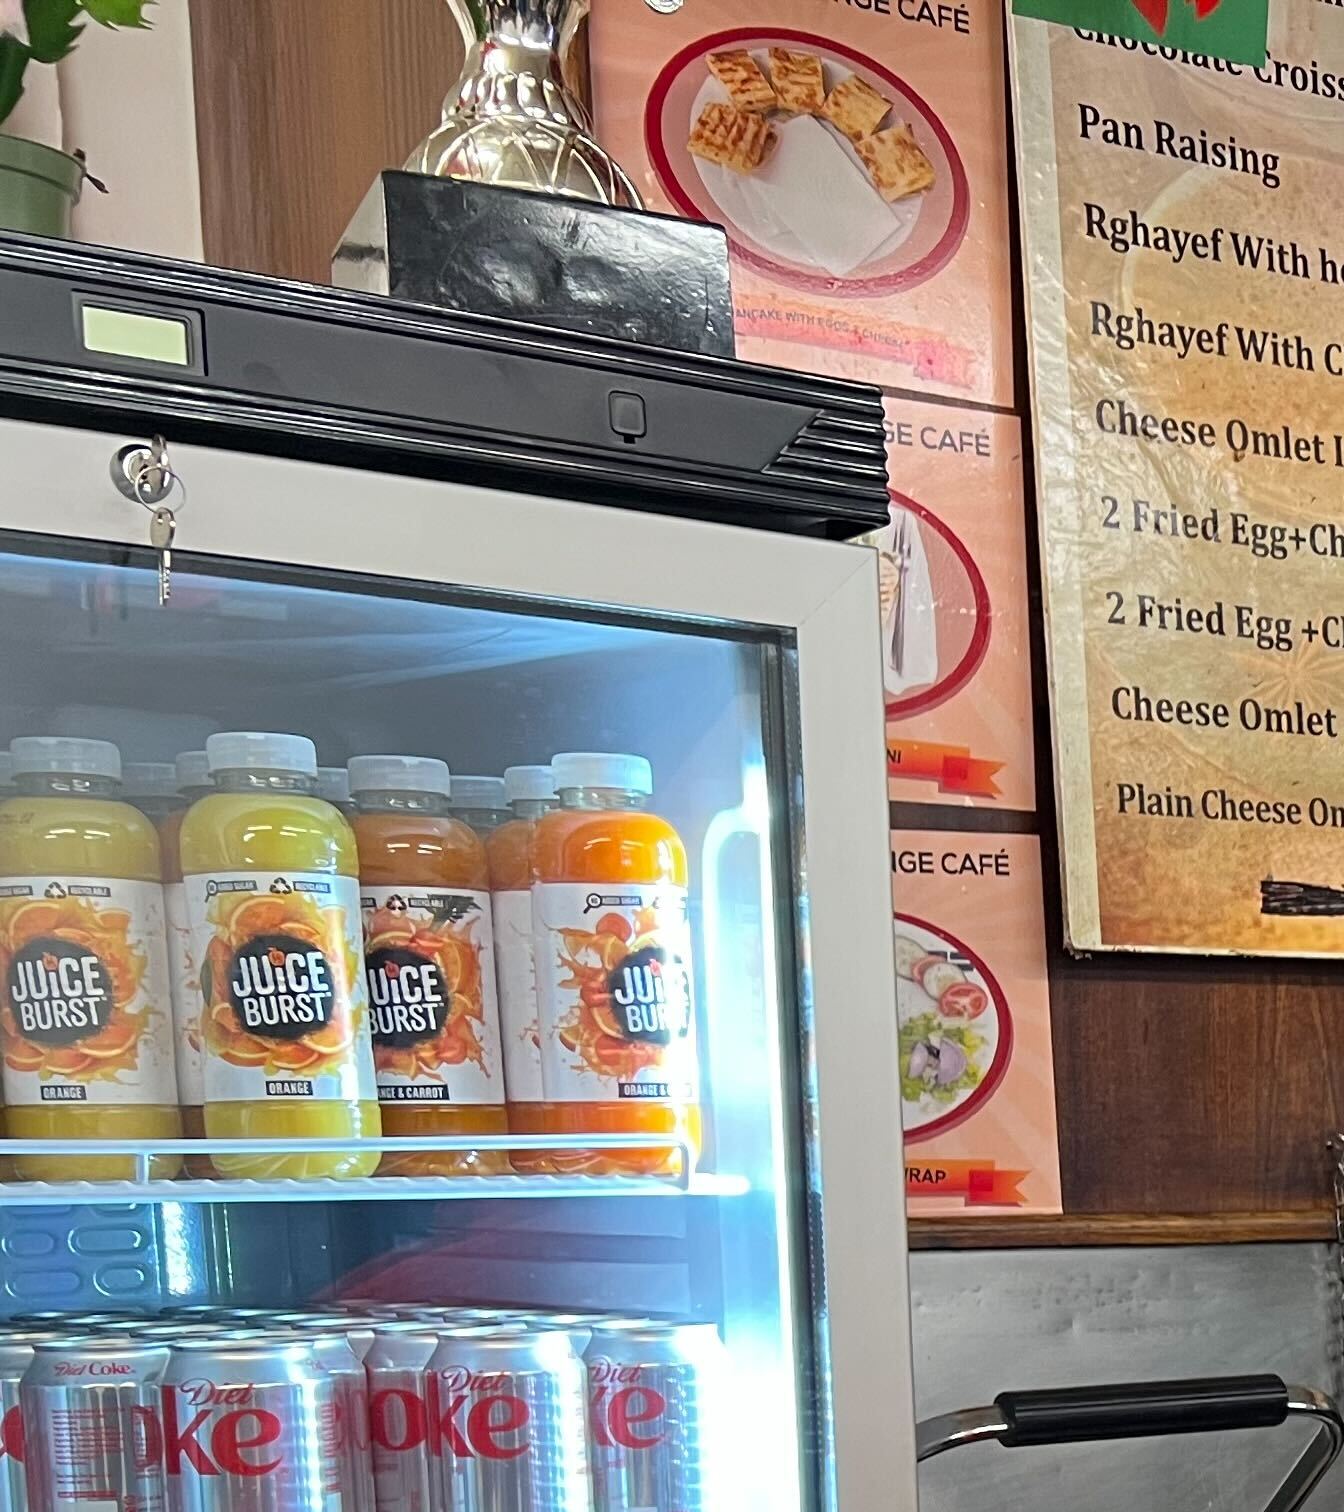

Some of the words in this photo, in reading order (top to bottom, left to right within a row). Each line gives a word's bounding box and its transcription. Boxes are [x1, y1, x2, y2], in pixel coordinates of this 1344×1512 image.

[898, 0, 969, 34] CAFÉ
[1078, 103, 1144, 150] Pan
[1154, 120, 1281, 189] Raising
[1083, 202, 1224, 264] Rghayef
[1231, 231, 1309, 280] With
[1090, 301, 1228, 359] Rghayef
[1235, 327, 1314, 372] With
[921, 428, 991, 457] CAFÉ
[1095, 399, 1217, 448] Cheese
[1226, 420, 1326, 465] Omlet
[1101, 496, 1120, 529] 2
[1132, 499, 1219, 542] Fried
[1106, 591, 1126, 625] 2
[1137, 594, 1225, 637] Fried
[1234, 606, 1292, 652] Egg
[1112, 686, 1229, 728] Cheese
[1239, 699, 1337, 738] Omlet
[1117, 783, 1195, 819] Plain
[1201, 788, 1301, 825] Cheese
[941, 848, 1011, 876] CAFÉ
[21, 999, 102, 1031] BURST
[244, 993, 331, 1027] BURST
[43, 1087, 83, 1099] ORANGE
[269, 1082, 309, 1095] ORANGE
[407, 1087, 444, 1099] CARROT
[624, 1084, 660, 1096] ORANGE
